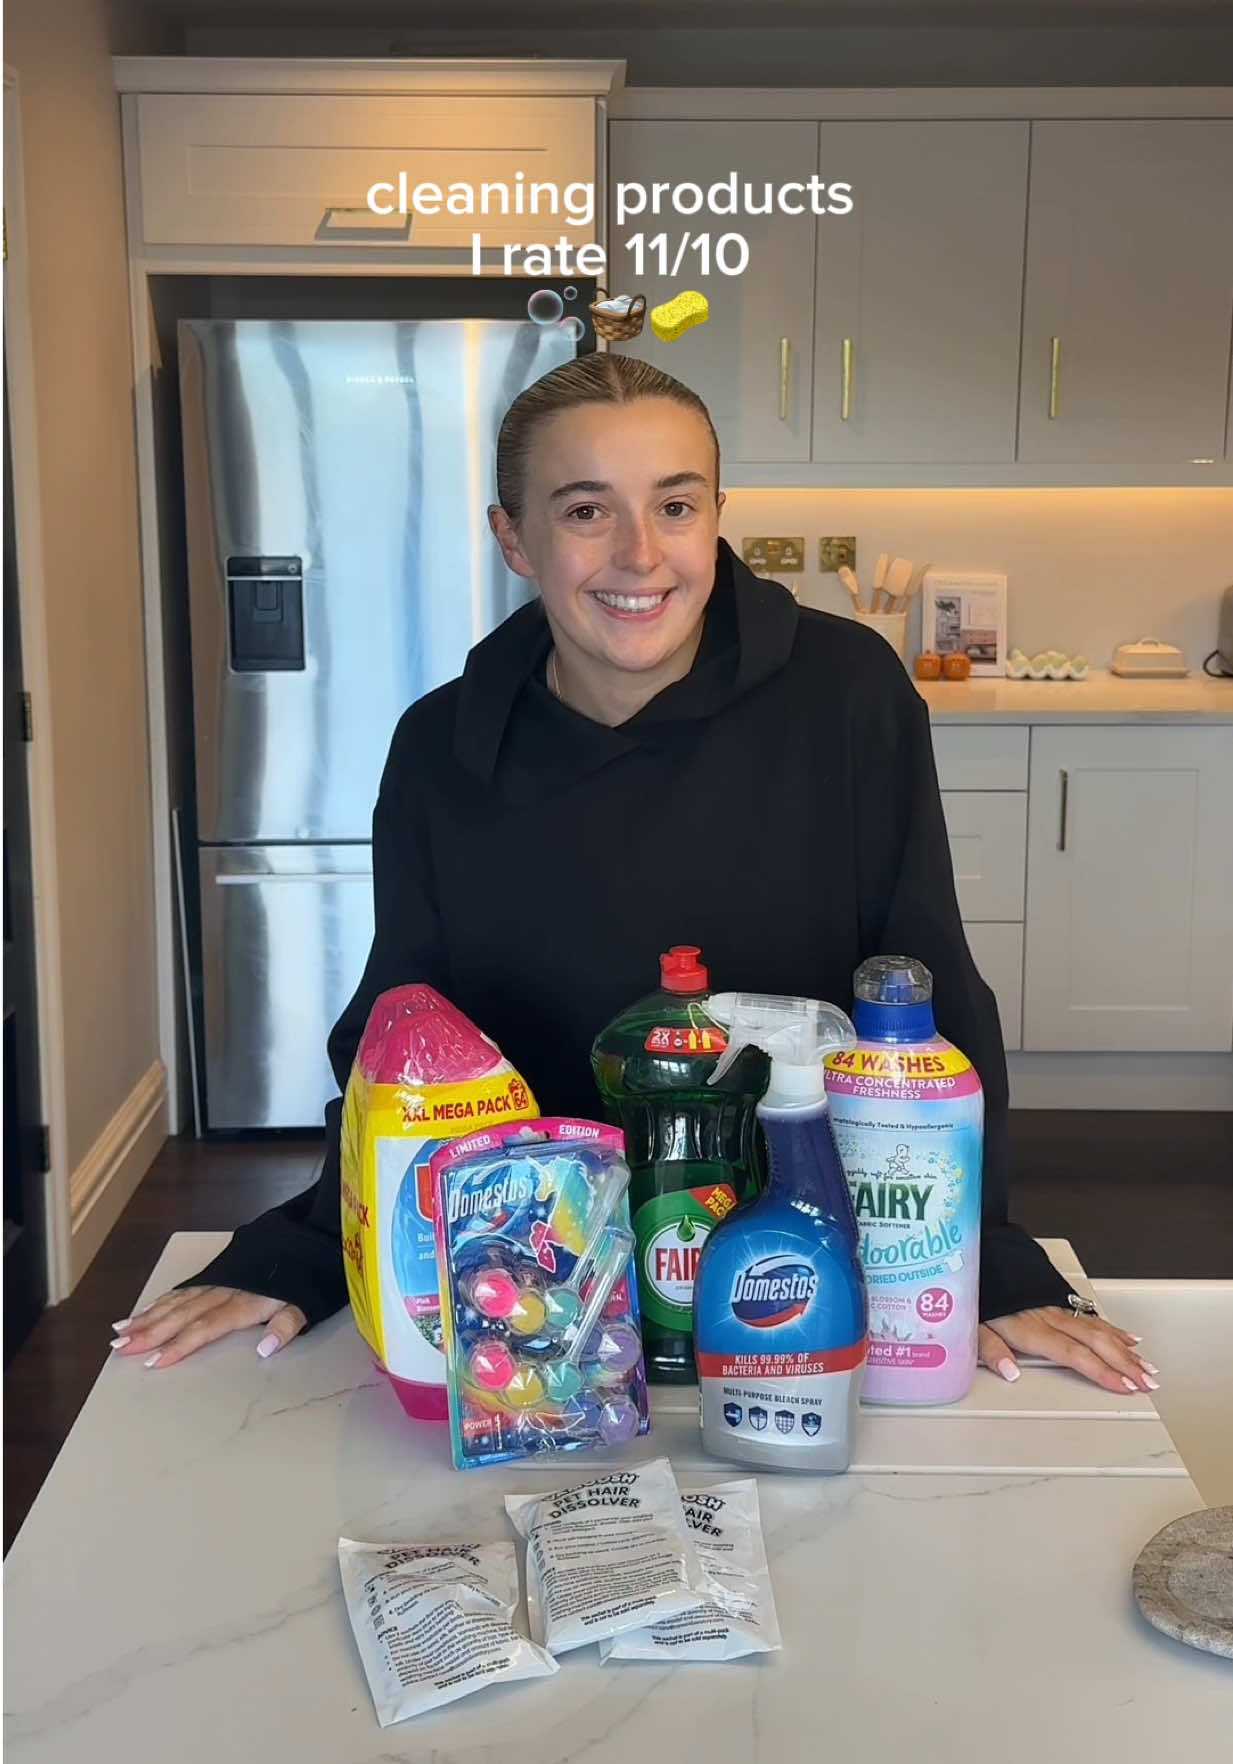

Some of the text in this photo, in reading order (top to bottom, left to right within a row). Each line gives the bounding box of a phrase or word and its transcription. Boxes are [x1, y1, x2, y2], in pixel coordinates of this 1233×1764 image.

[832, 1051, 946, 1074] 84 WASHES
[852, 1085, 921, 1100] FRESHNESS
[855, 1076, 956, 1090] CONCENTRATED
[402, 1095, 512, 1122] XXL MEGA PACK
[559, 1124, 600, 1139] EDITION
[451, 1134, 492, 1159] LIMITED
[447, 1172, 532, 1224] Domestos
[898, 1264, 944, 1283] OUTSIDE
[731, 1271, 819, 1303] Domestos
[919, 1292, 950, 1312] 84
[735, 1353, 810, 1365] KILLS 99.99% OF
[896, 1345, 911, 1358] #1
[722, 1362, 824, 1376] BACTERIA AND VIRUSES
[774, 1394, 800, 1404] BLEACH
[801, 1397, 823, 1406] SPRAY
[553, 1492, 581, 1508] PET
[588, 1486, 629, 1497] HAIR
[549, 1498, 640, 1519] DISSOLVER
